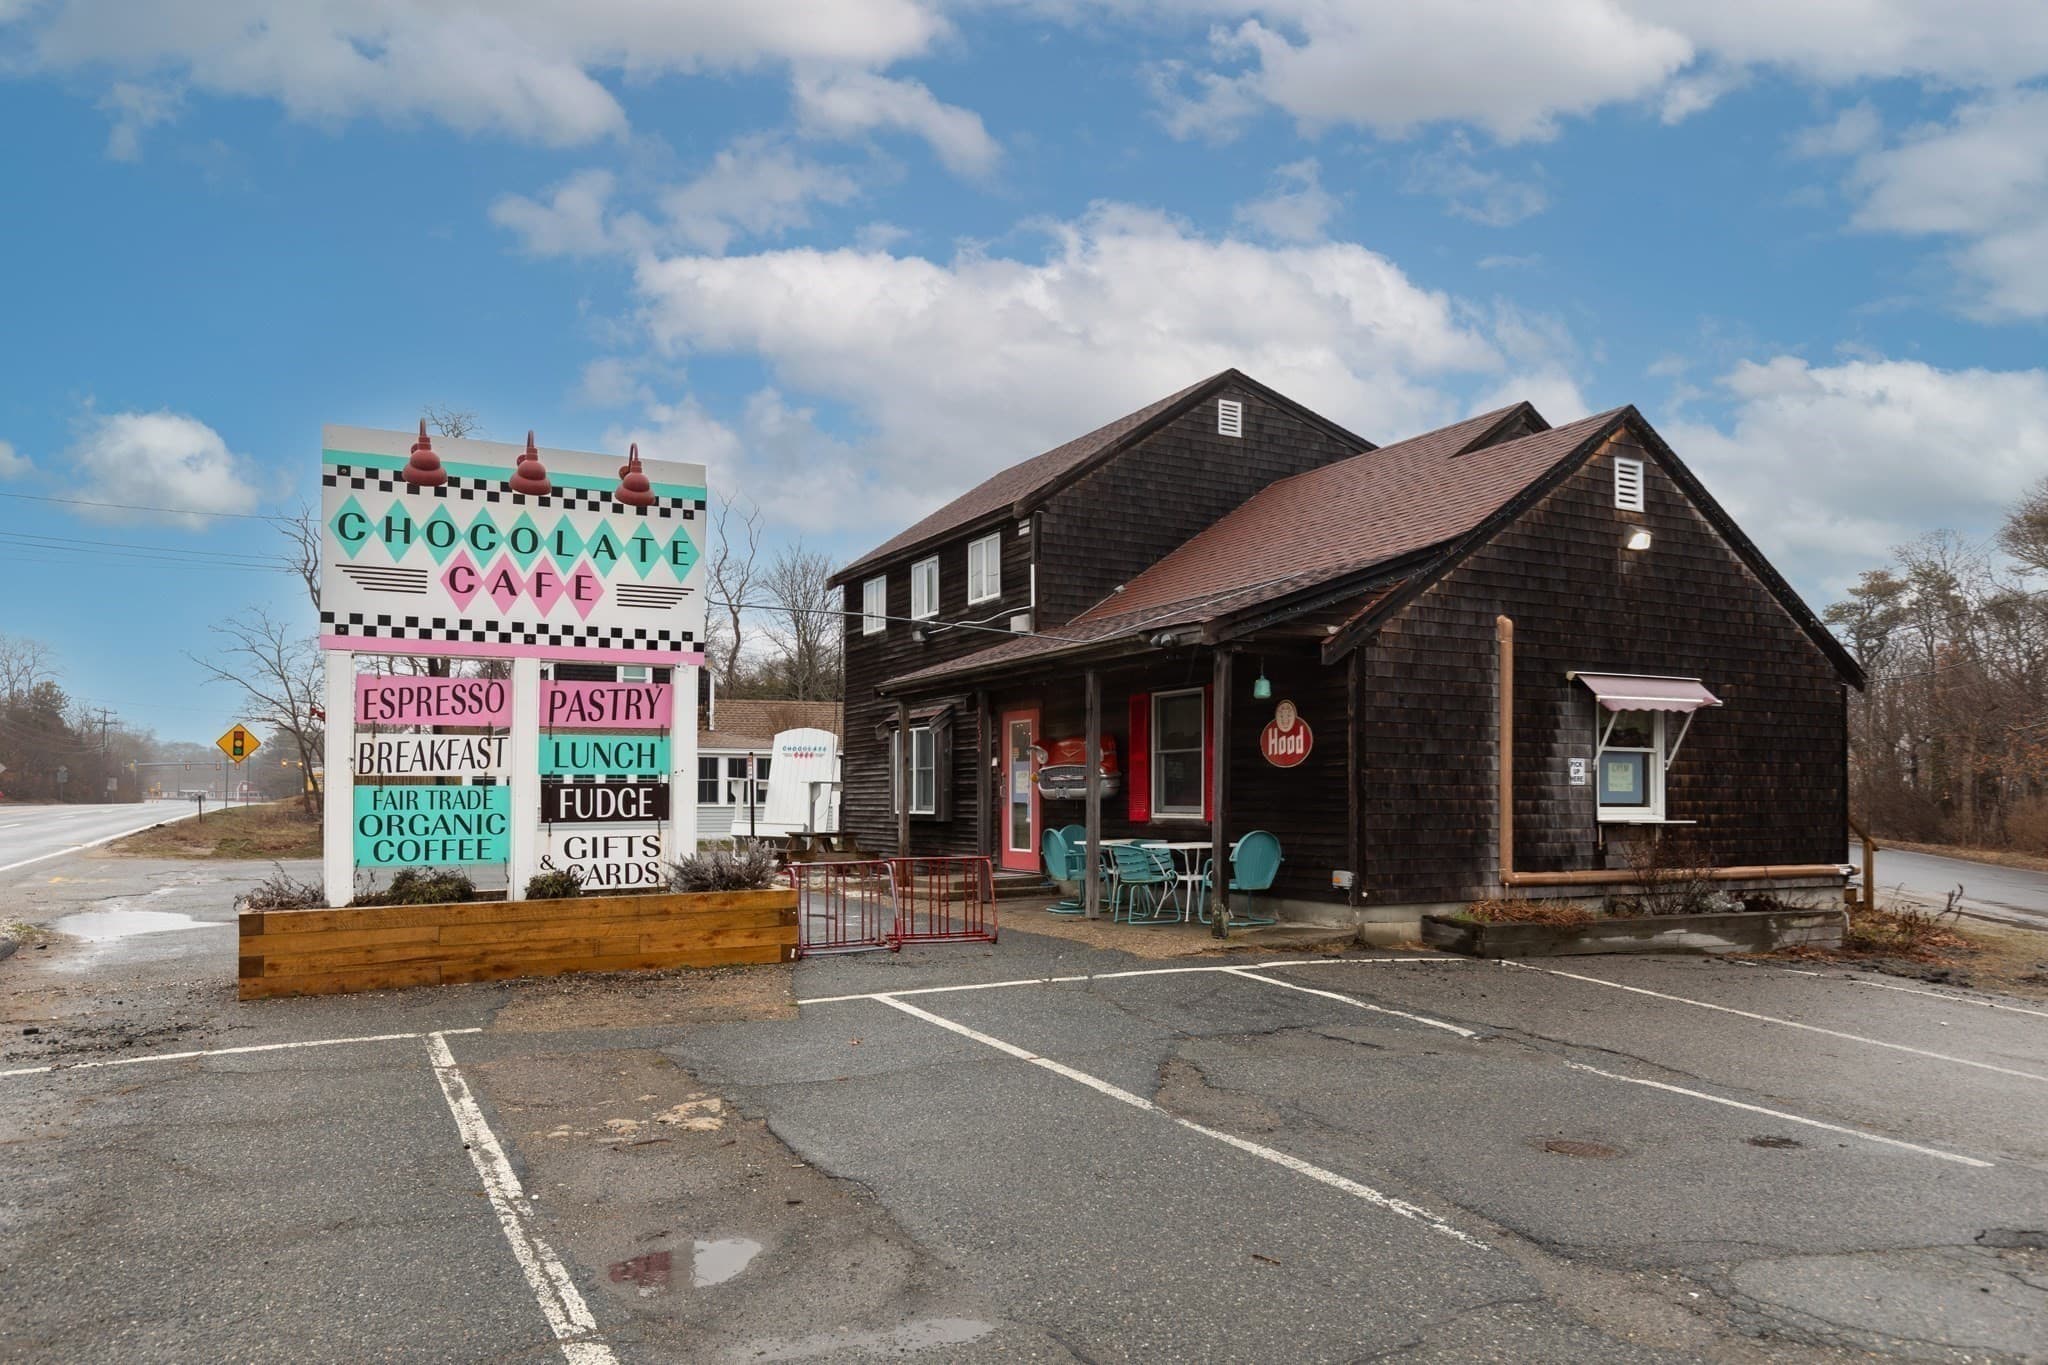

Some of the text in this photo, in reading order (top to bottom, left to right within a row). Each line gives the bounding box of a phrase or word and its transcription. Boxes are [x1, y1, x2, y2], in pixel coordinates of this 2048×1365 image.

[337, 512, 690, 566] CHOCOLATE
[448, 566, 593, 601] CAFE
[362, 681, 505, 720] ESPRESSO
[549, 687, 663, 723] PASTRY
[358, 737, 508, 775] BREAKFAST
[553, 742, 656, 769] LUNCH
[1267, 725, 1304, 756] Hood
[373, 789, 493, 811] FAIR TRADE
[559, 787, 654, 819] FUDGE
[359, 813, 506, 837] ORGANIC
[373, 838, 492, 863] COFFEE
[563, 834, 661, 860] GIFTS
[540, 854, 660, 886] & CARDS
